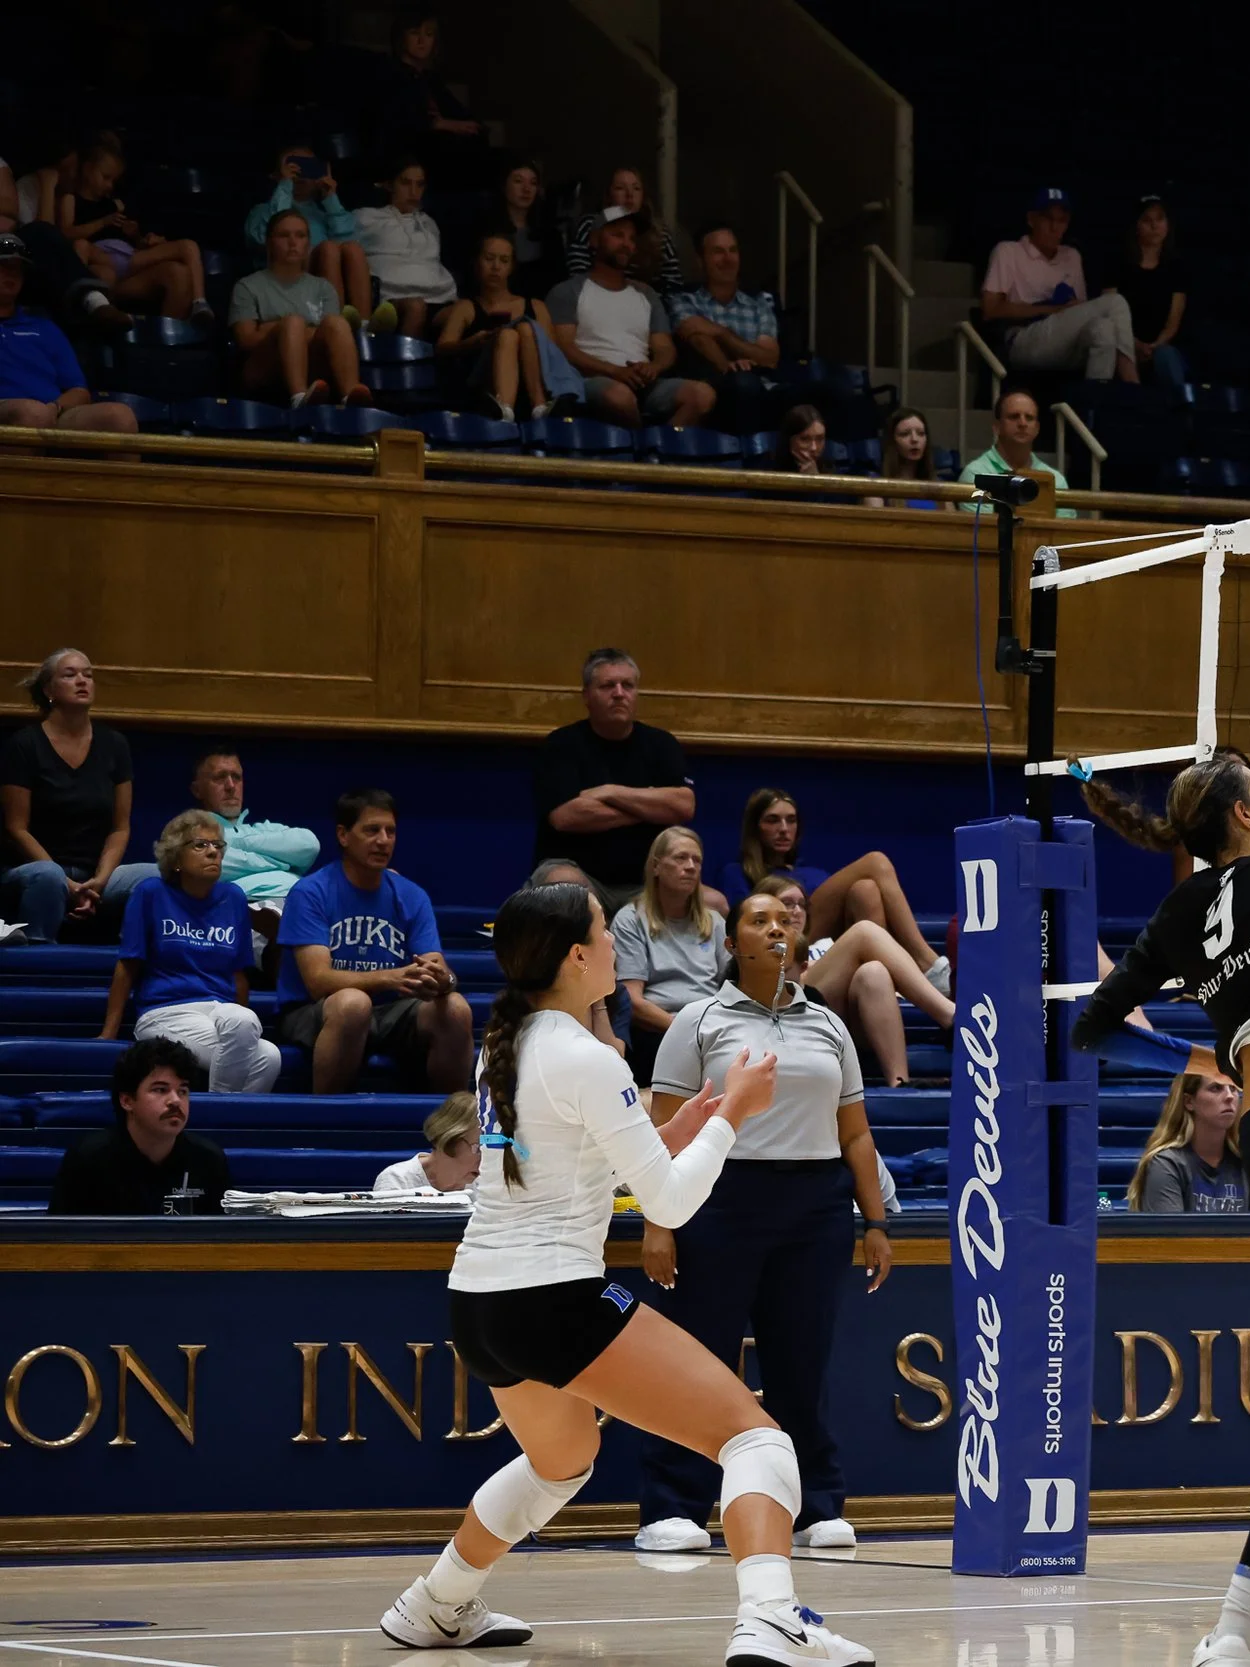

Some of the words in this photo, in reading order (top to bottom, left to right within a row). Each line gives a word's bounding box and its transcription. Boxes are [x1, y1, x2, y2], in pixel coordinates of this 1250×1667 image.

[162, 918, 205, 940] Duke
[206, 926, 236, 945] 100
[960, 858, 998, 934] D
[1202, 878, 1235, 960] 9
[329, 916, 405, 960] DUKE
[957, 993, 1005, 1281] Devils
[1046, 1273, 1066, 1352] sports
[0, 1342, 207, 1449] ON
[957, 1293, 1002, 1509] Blue
[1023, 1478, 1076, 1533] D
[1020, 1556, 1042, 1568] (800)
[1043, 1555, 1077, 1567] 556-3198
